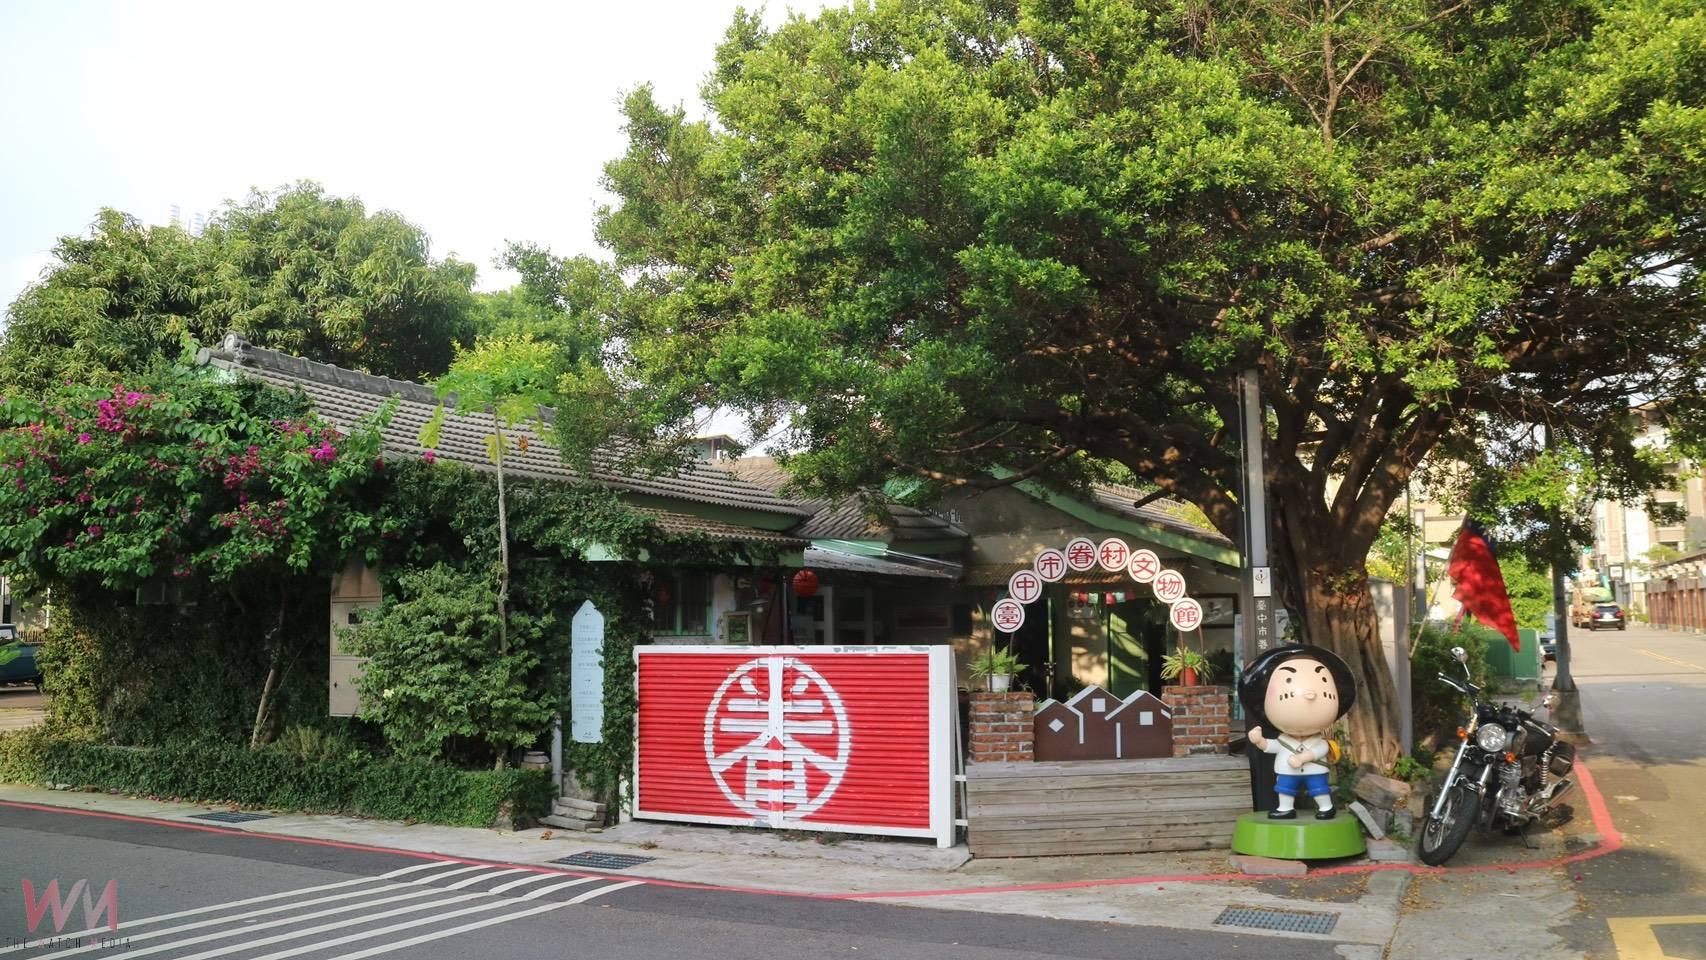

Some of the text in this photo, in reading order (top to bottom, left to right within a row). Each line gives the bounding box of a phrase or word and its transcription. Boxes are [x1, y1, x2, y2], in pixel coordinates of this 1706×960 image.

[996, 543, 1200, 626] 臺中市眷村文物館
